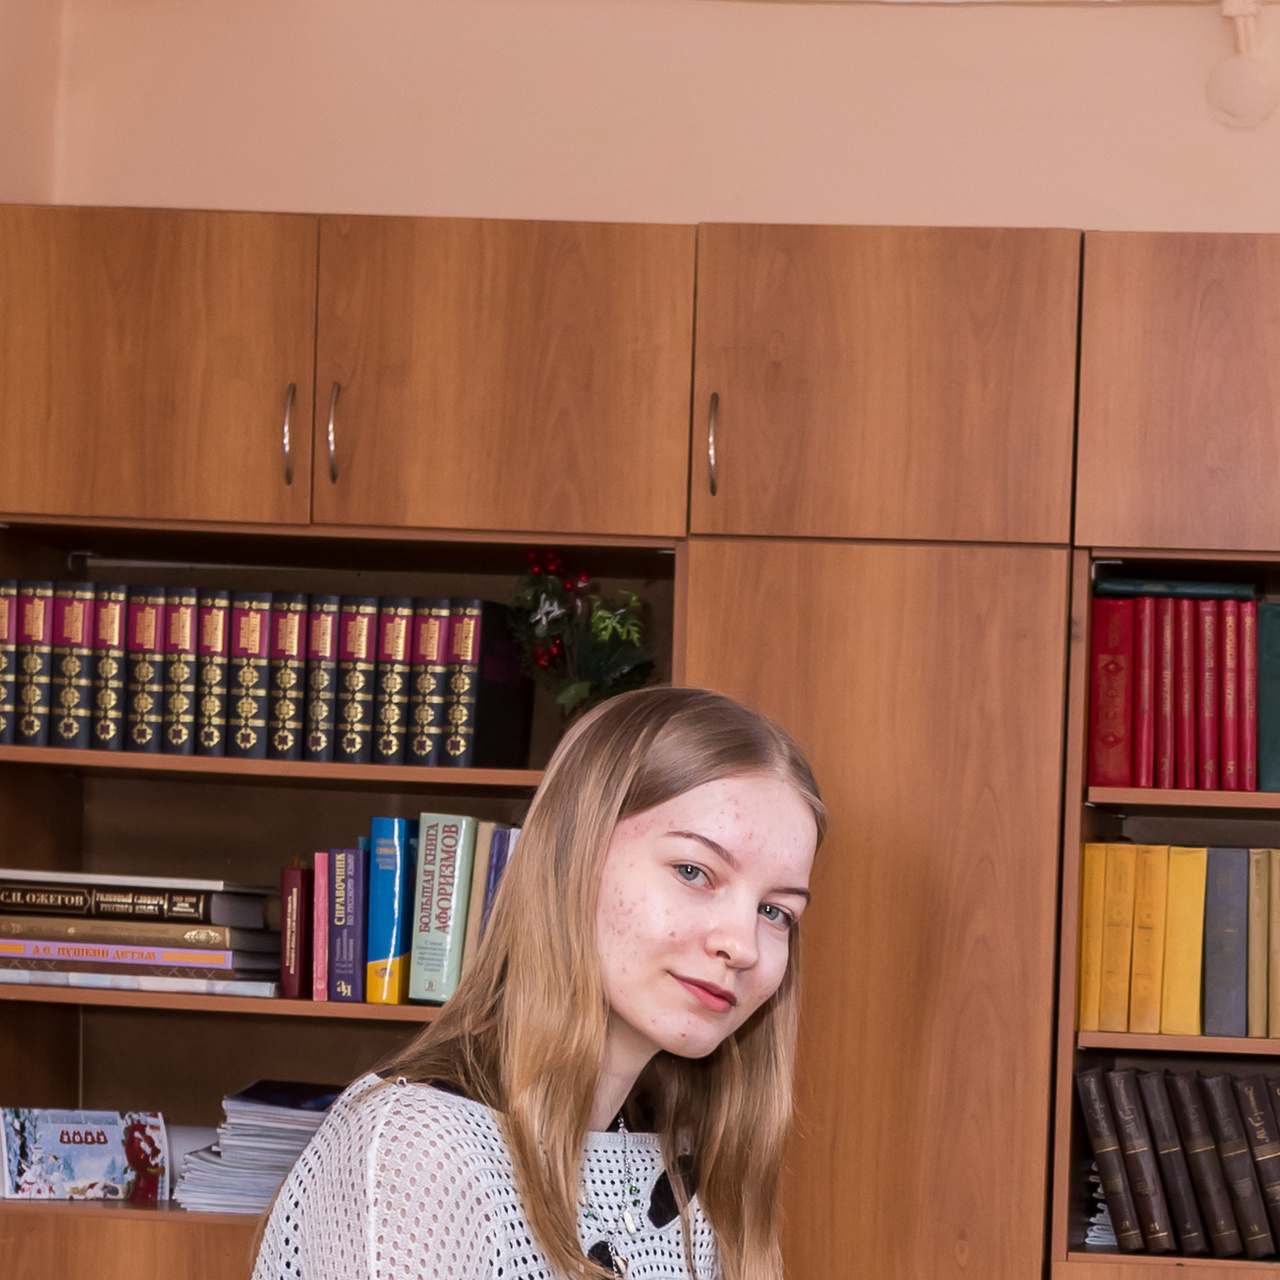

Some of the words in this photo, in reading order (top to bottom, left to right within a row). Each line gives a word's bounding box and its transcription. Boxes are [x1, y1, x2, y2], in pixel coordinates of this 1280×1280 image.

[424, 823, 439, 867] КНИГА
[26, 892, 84, 907] ОЖЕГОВ
[419, 868, 436, 934] БОЛЬШАЯ
[434, 823, 459, 935] АФОРИЗМОВ
[57, 946, 109, 960] ПУШКИН
